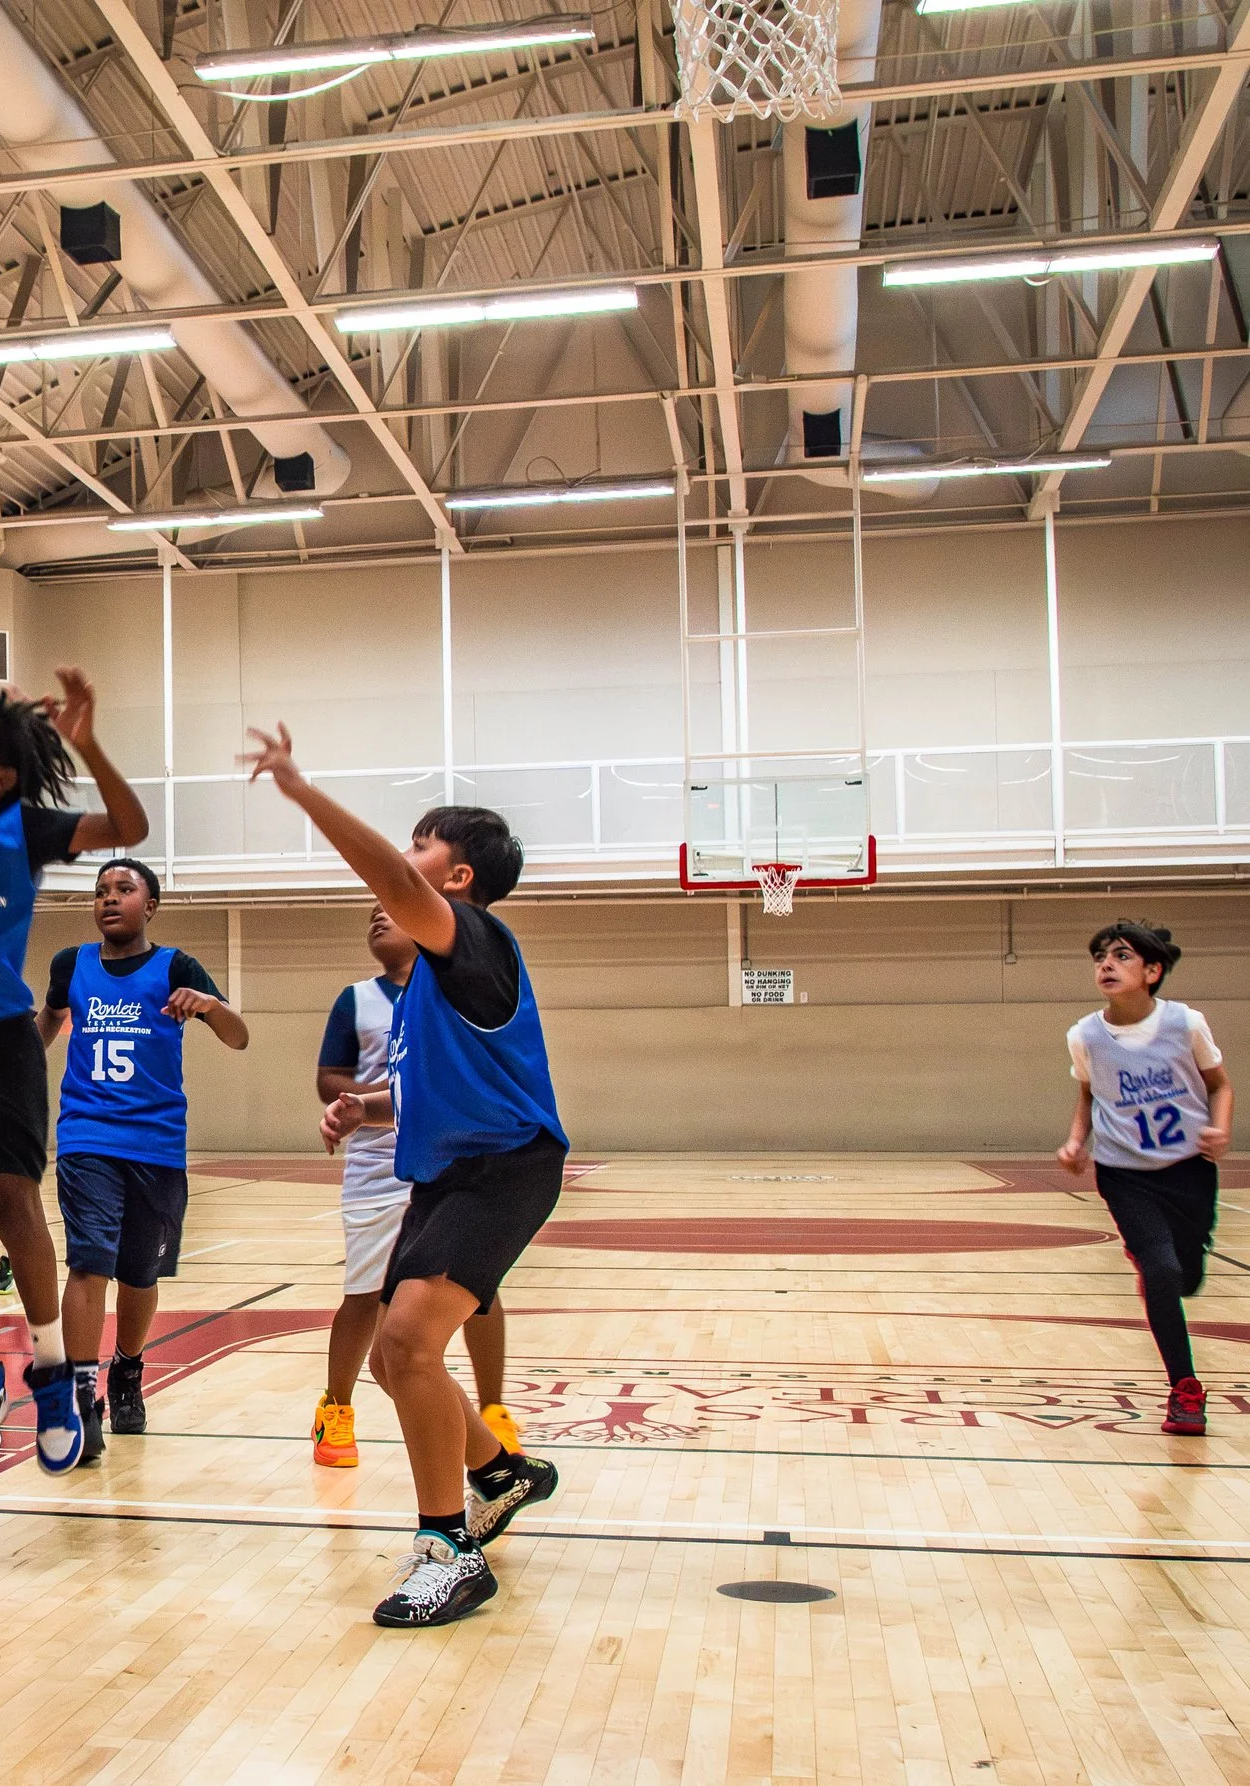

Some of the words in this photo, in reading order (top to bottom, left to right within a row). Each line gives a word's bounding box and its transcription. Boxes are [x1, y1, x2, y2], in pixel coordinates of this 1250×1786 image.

[86, 996, 143, 1024] Rowlett
[105, 1026, 152, 1035] RECREATION
[91, 1038, 135, 1082] 15
[1133, 1103, 1187, 1150] 12
[357, 1379, 1250, 1415] RECREATIO
[693, 1402, 1230, 1437] PARKS
